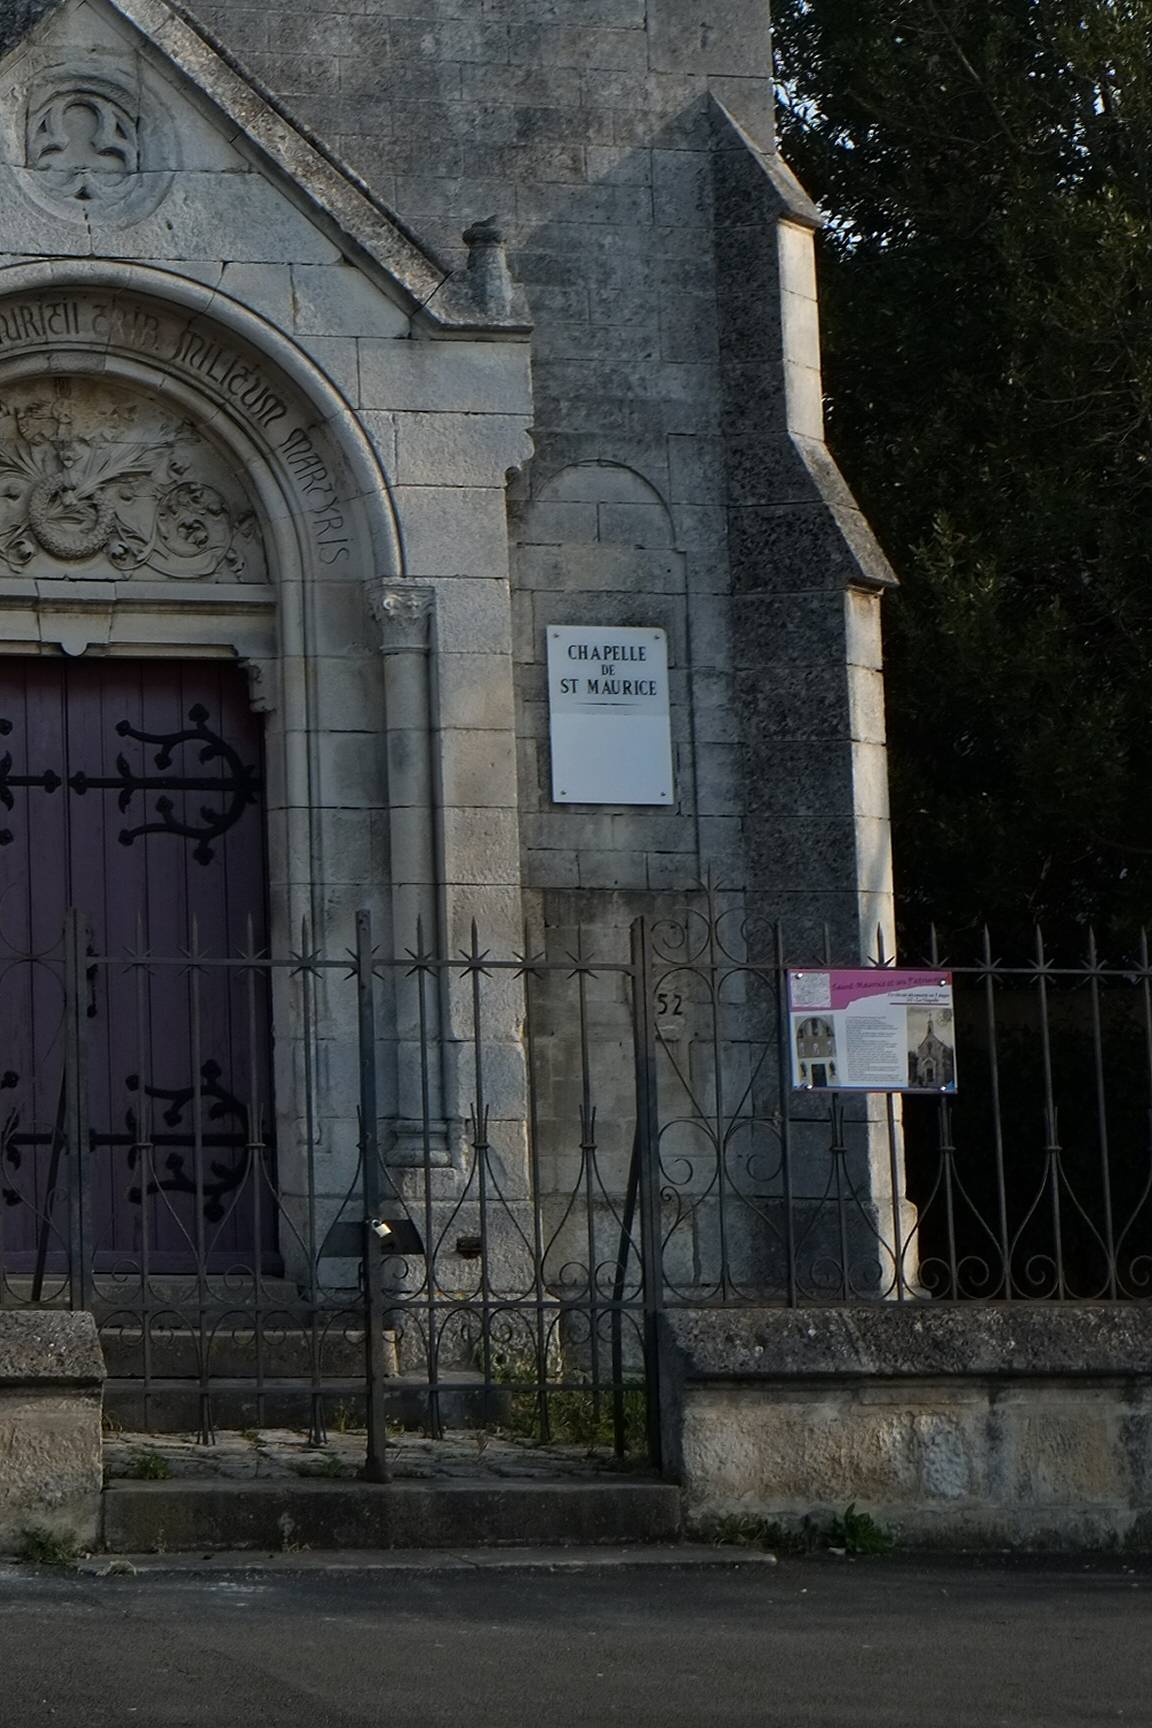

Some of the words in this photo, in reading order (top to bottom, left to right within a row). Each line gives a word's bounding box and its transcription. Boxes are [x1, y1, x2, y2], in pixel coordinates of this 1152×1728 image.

[567, 644, 647, 662] CHAPELLE
[601, 664, 616, 676] DE
[560, 678, 579, 694] ST
[587, 679, 657, 696] MAURICE
[657, 993, 683, 1016] 52
